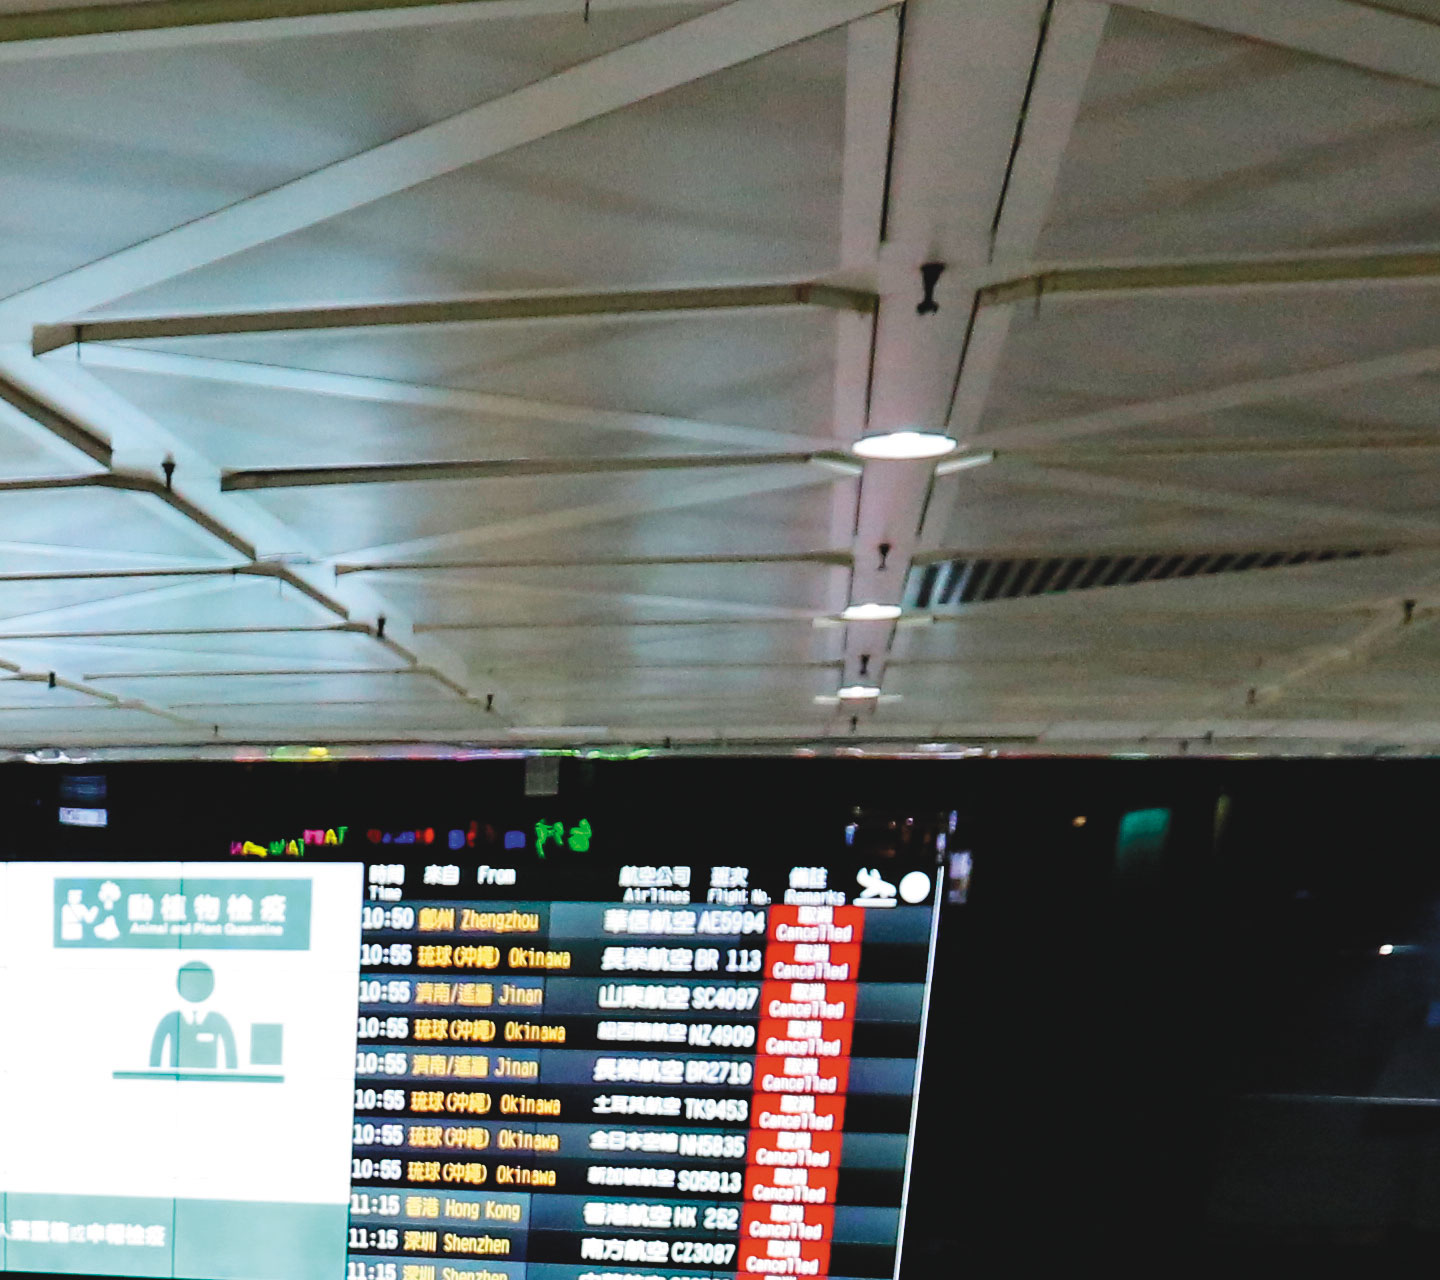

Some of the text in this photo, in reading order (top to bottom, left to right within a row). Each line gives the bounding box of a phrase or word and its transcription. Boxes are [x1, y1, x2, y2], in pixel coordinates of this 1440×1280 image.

[478, 865, 516, 885] From
[363, 907, 414, 929] 10:50
[460, 909, 539, 932] Zhengzhou
[361, 944, 412, 965] 10:55
[508, 947, 570, 968] Okinawa
[726, 949, 761, 971] 113
[360, 981, 410, 1002] 10:55
[498, 985, 542, 1005] Jinan
[358, 1017, 409, 1038] 10:55
[505, 1021, 566, 1042] Okinawa
[356, 1053, 407, 1075] 10:55
[494, 1057, 538, 1076] Jinan
[355, 1089, 405, 1110] 10:55
[500, 1094, 561, 1115] Okinawa
[353, 1124, 404, 1145] 10:55
[498, 1130, 559, 1151] Okinawa
[352, 1159, 402, 1180] 10:55
[496, 1165, 556, 1186] Okinawa
[351, 1194, 400, 1215] 11:15
[406, 1197, 439, 1218] 香港
[445, 1200, 480, 1220] Hong
[485, 1201, 520, 1221] Kong
[704, 1207, 739, 1230] 252
[349, 1228, 398, 1249] 11:15
[444, 1234, 510, 1254] Shenzhen
